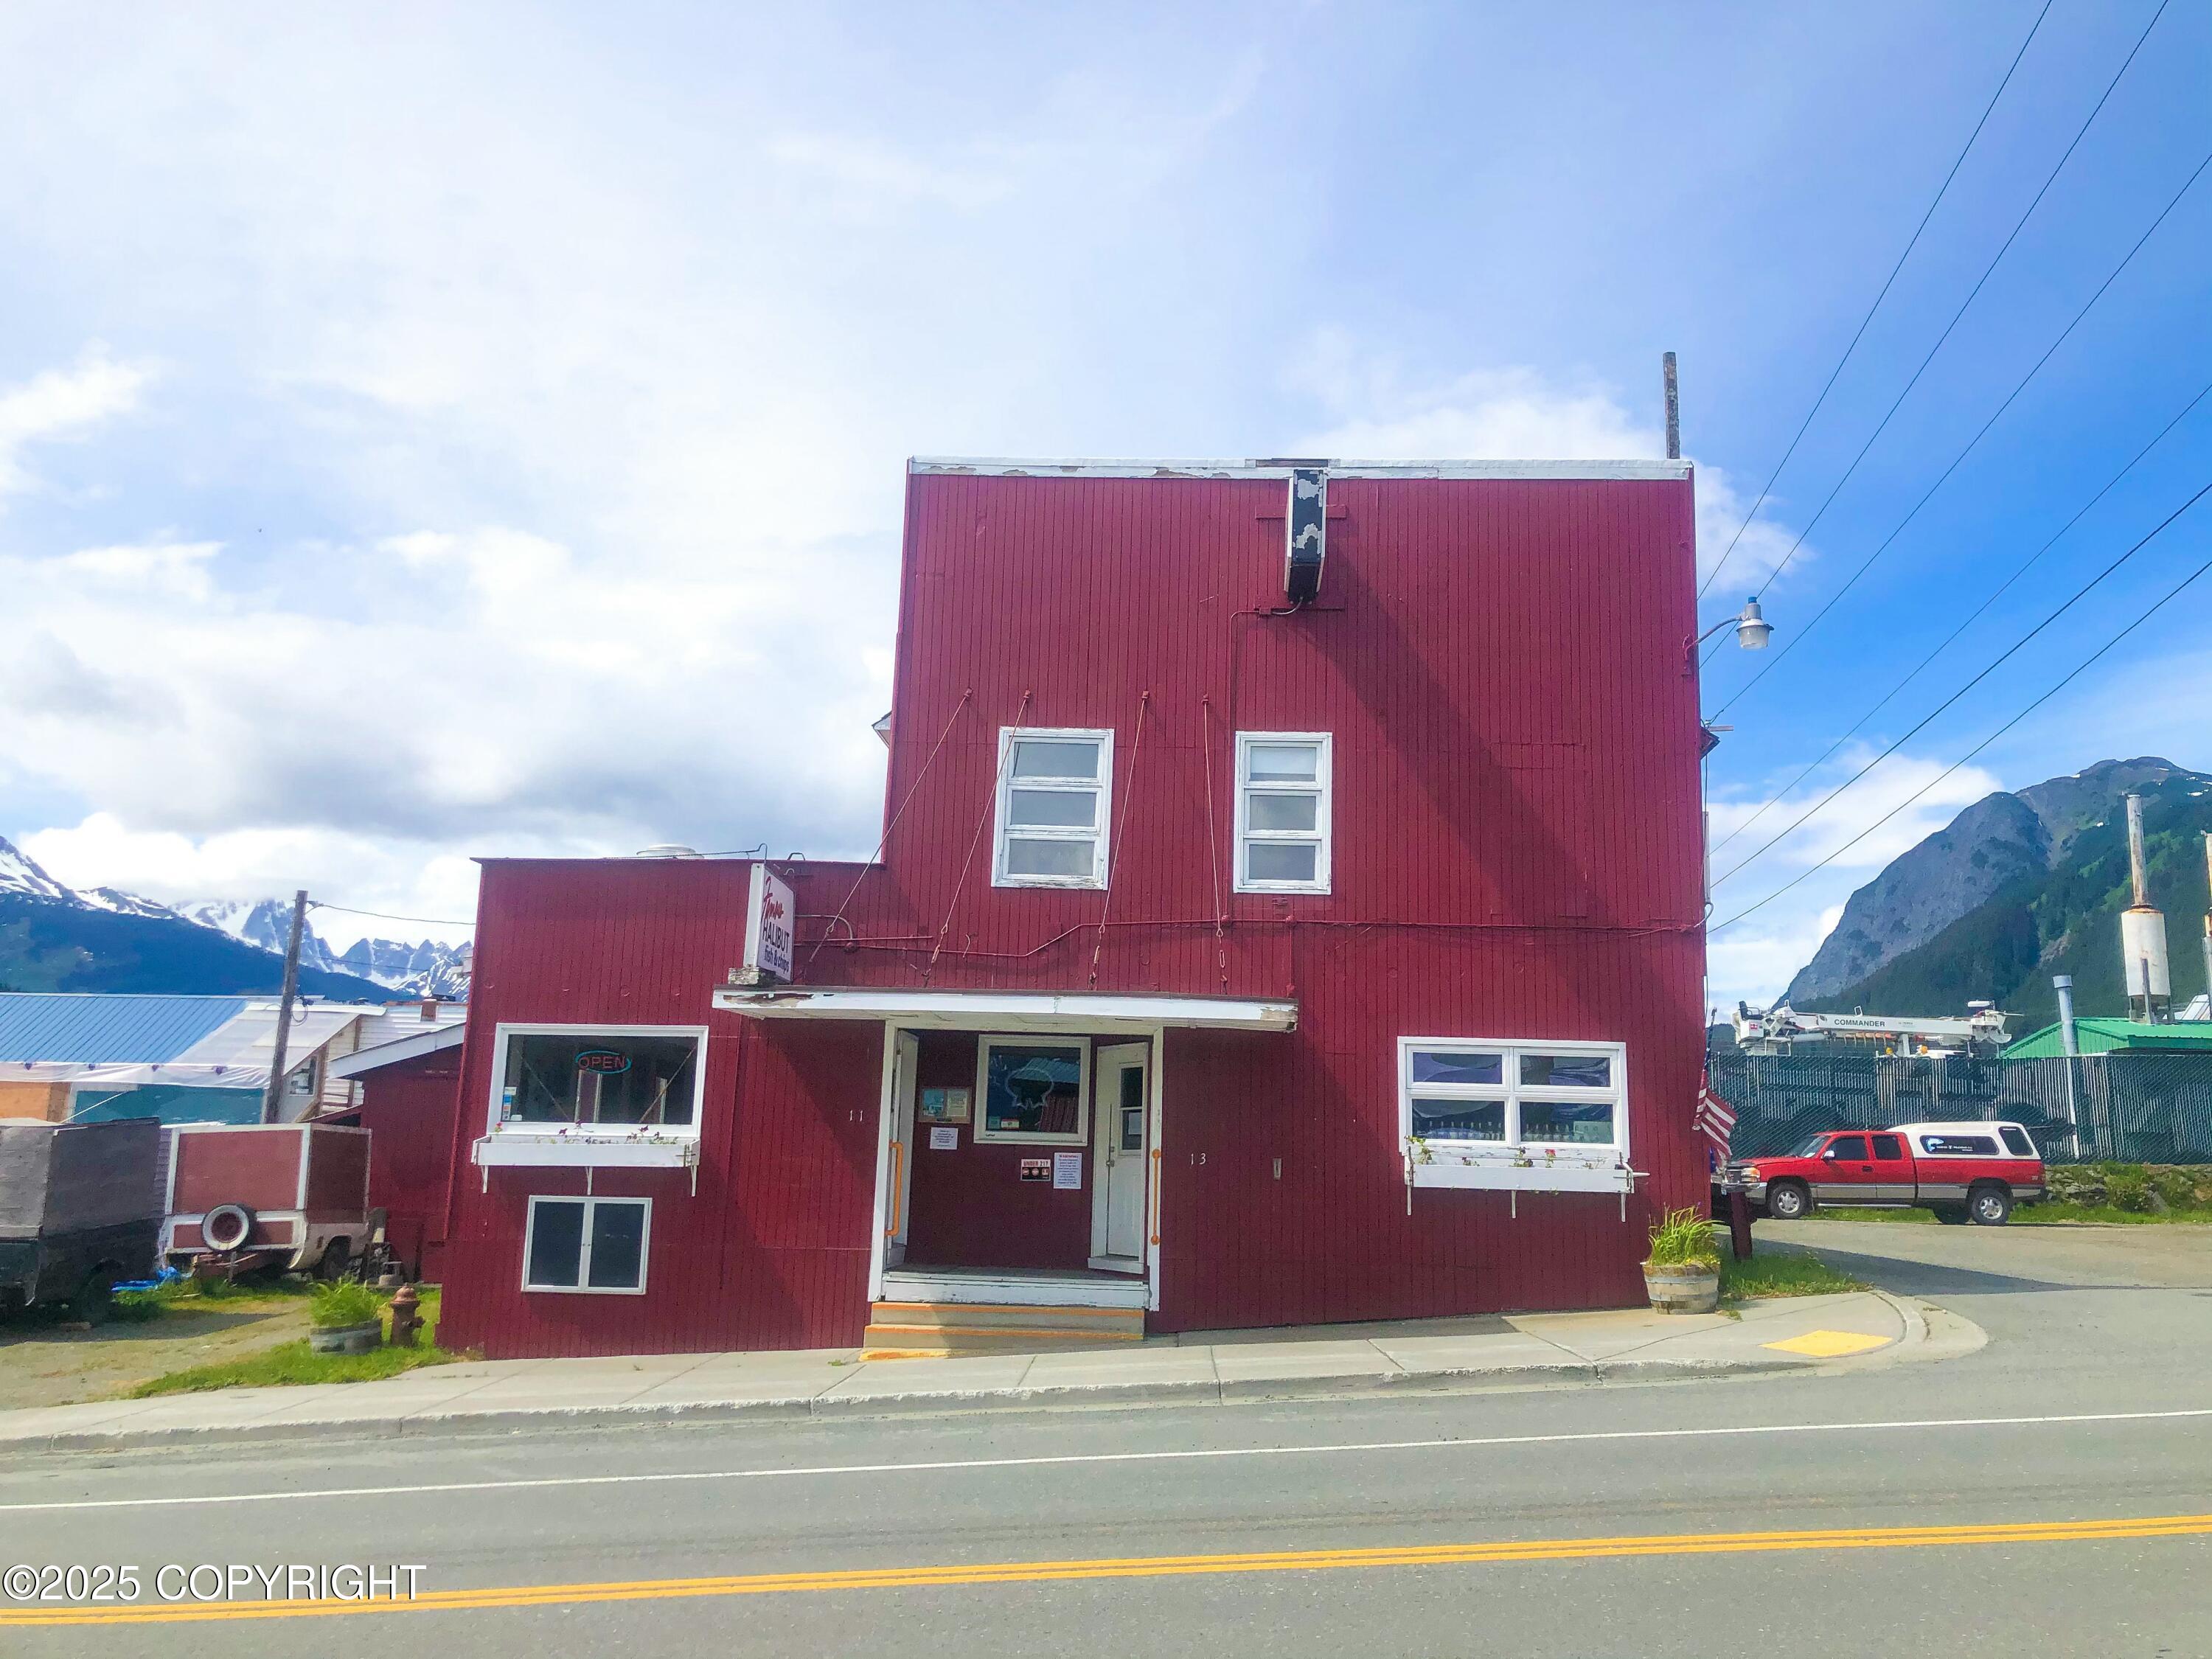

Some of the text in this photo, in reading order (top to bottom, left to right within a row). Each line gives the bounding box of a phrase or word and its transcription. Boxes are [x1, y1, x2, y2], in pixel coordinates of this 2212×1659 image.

[762, 918, 790, 953] HALIBUT
[773, 949, 778, 967] &
[1834, 1018, 1885, 1027] COMMANDER
[578, 1054, 625, 1070] OPEN
[849, 1110, 863, 1121] 11
[1191, 1152, 1206, 1165] 13
